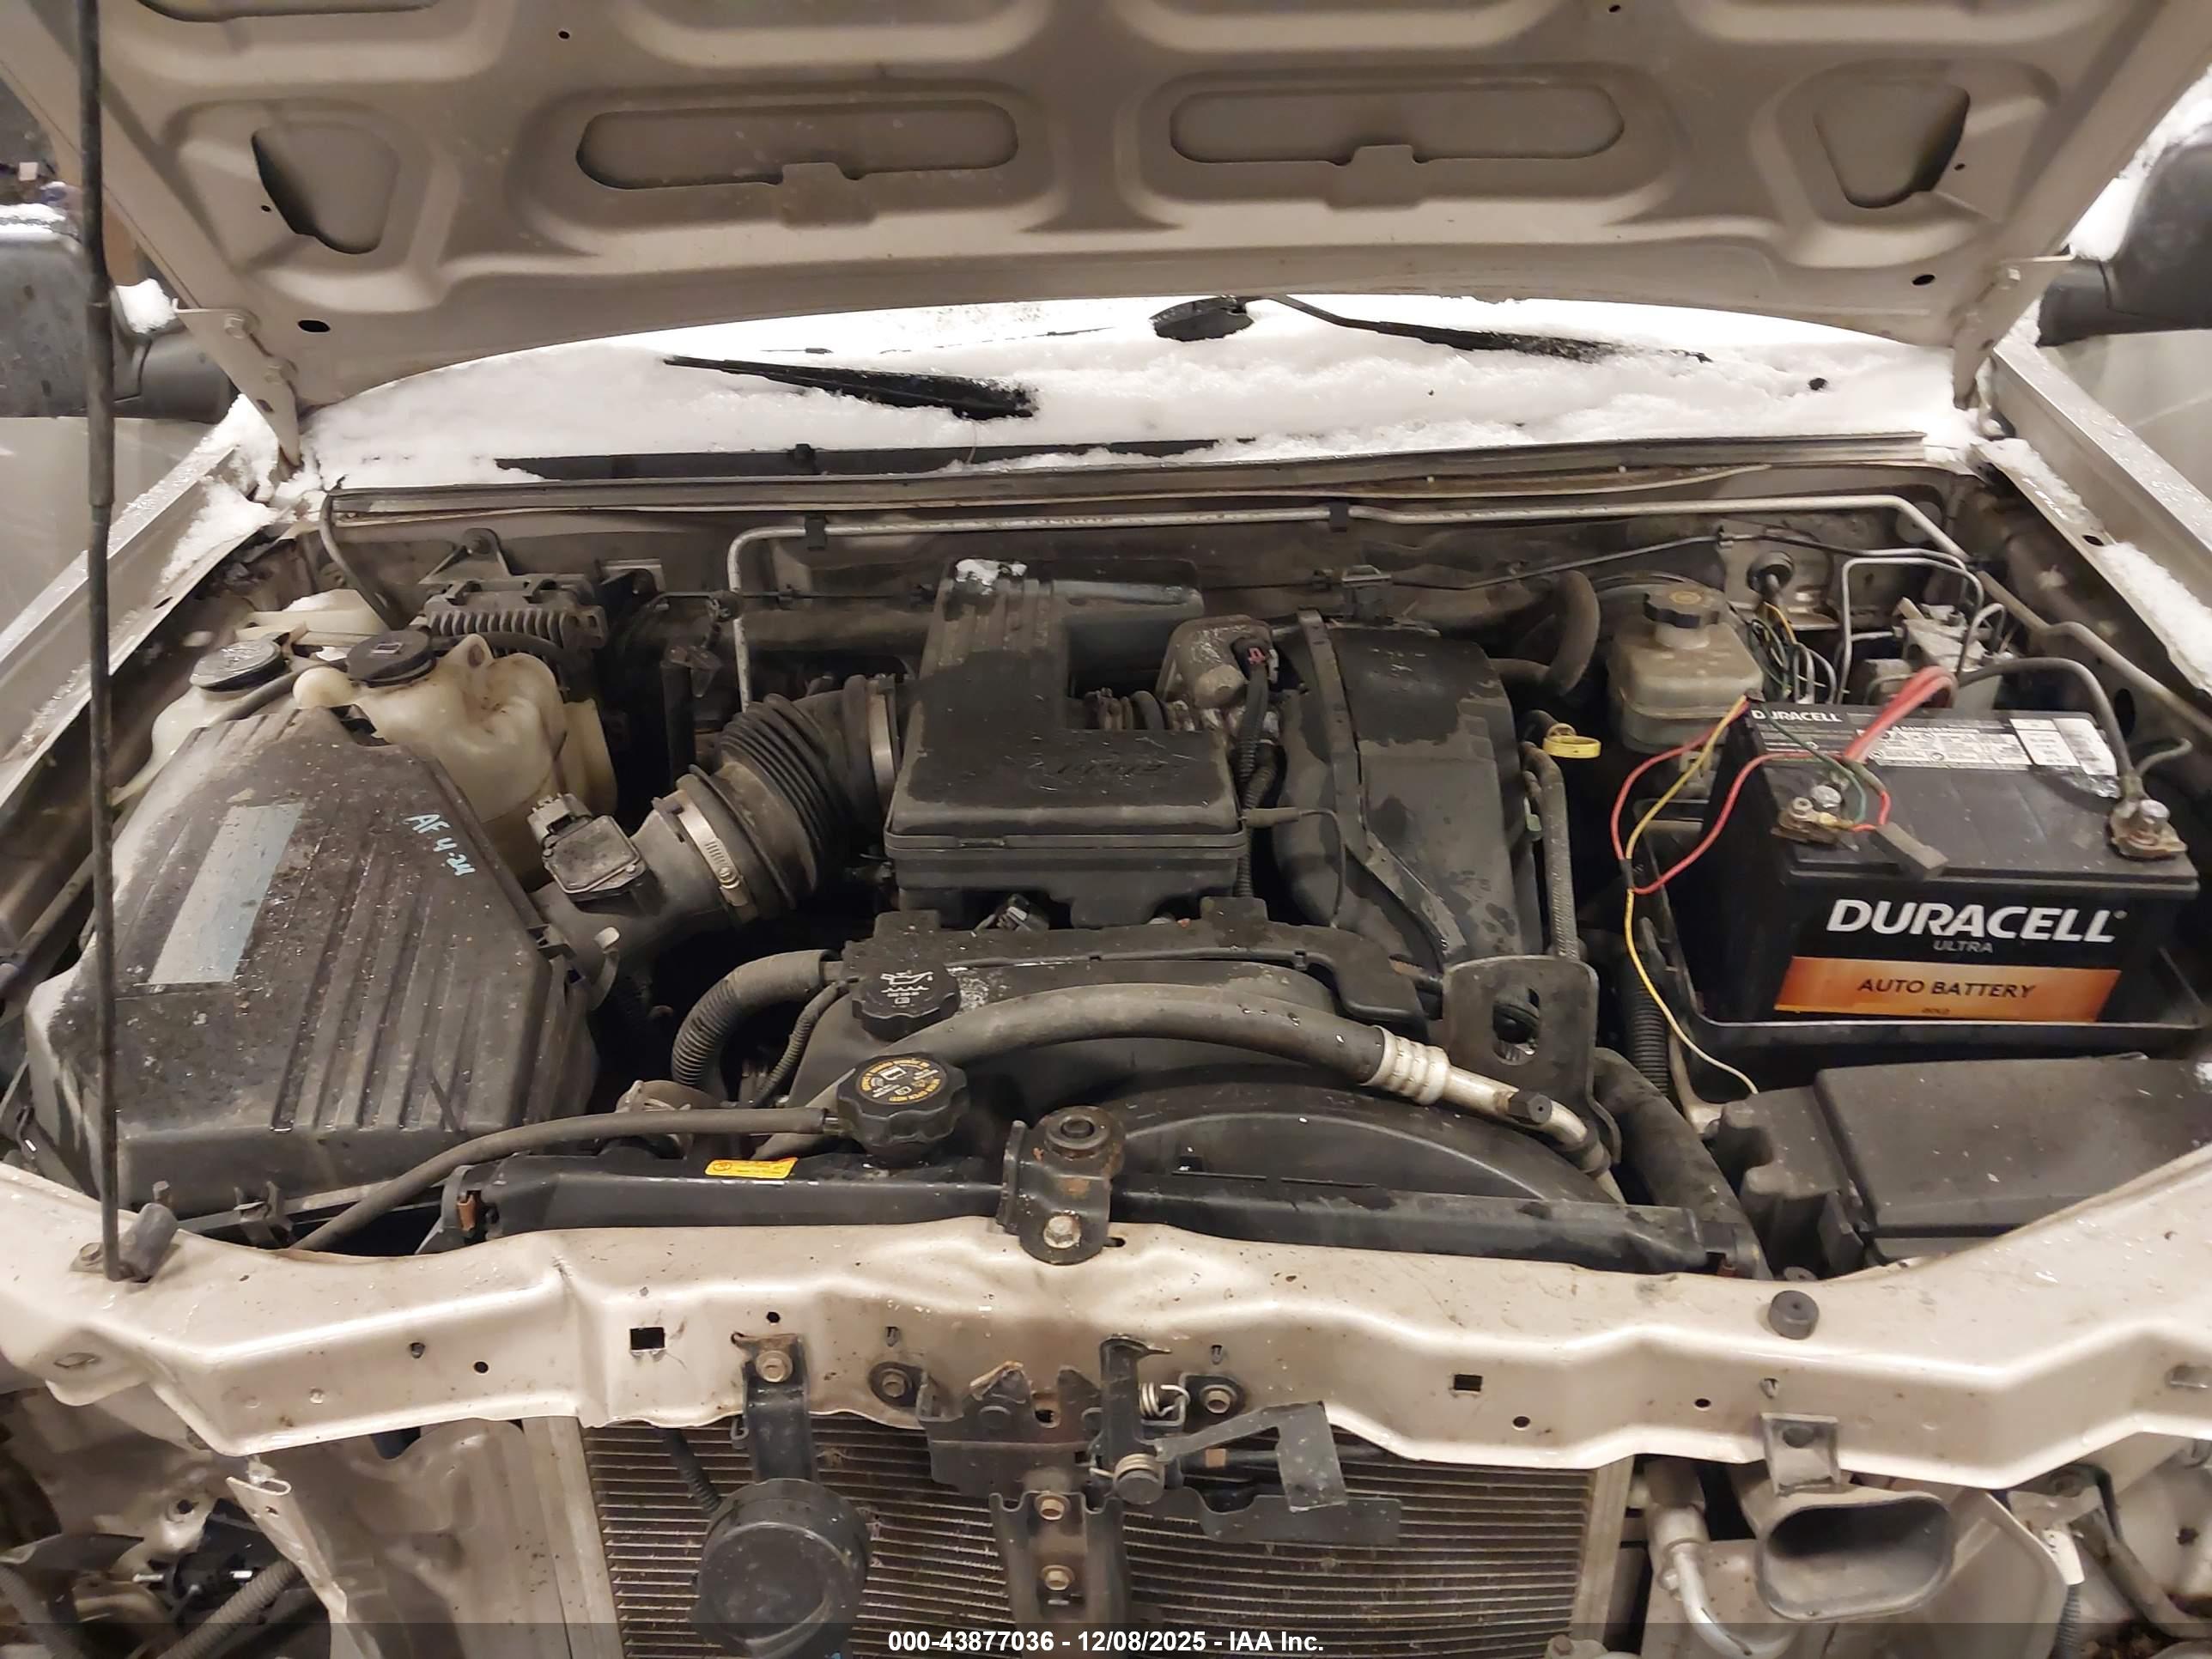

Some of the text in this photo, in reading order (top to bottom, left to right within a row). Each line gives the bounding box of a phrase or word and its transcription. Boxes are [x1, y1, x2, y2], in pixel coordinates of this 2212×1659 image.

[404, 813, 451, 834] AF
[1826, 898, 2117, 944] DURACELL
[1932, 939, 1994, 955] ULTRA
[1857, 978, 2036, 1000] AUTO BATTERY
